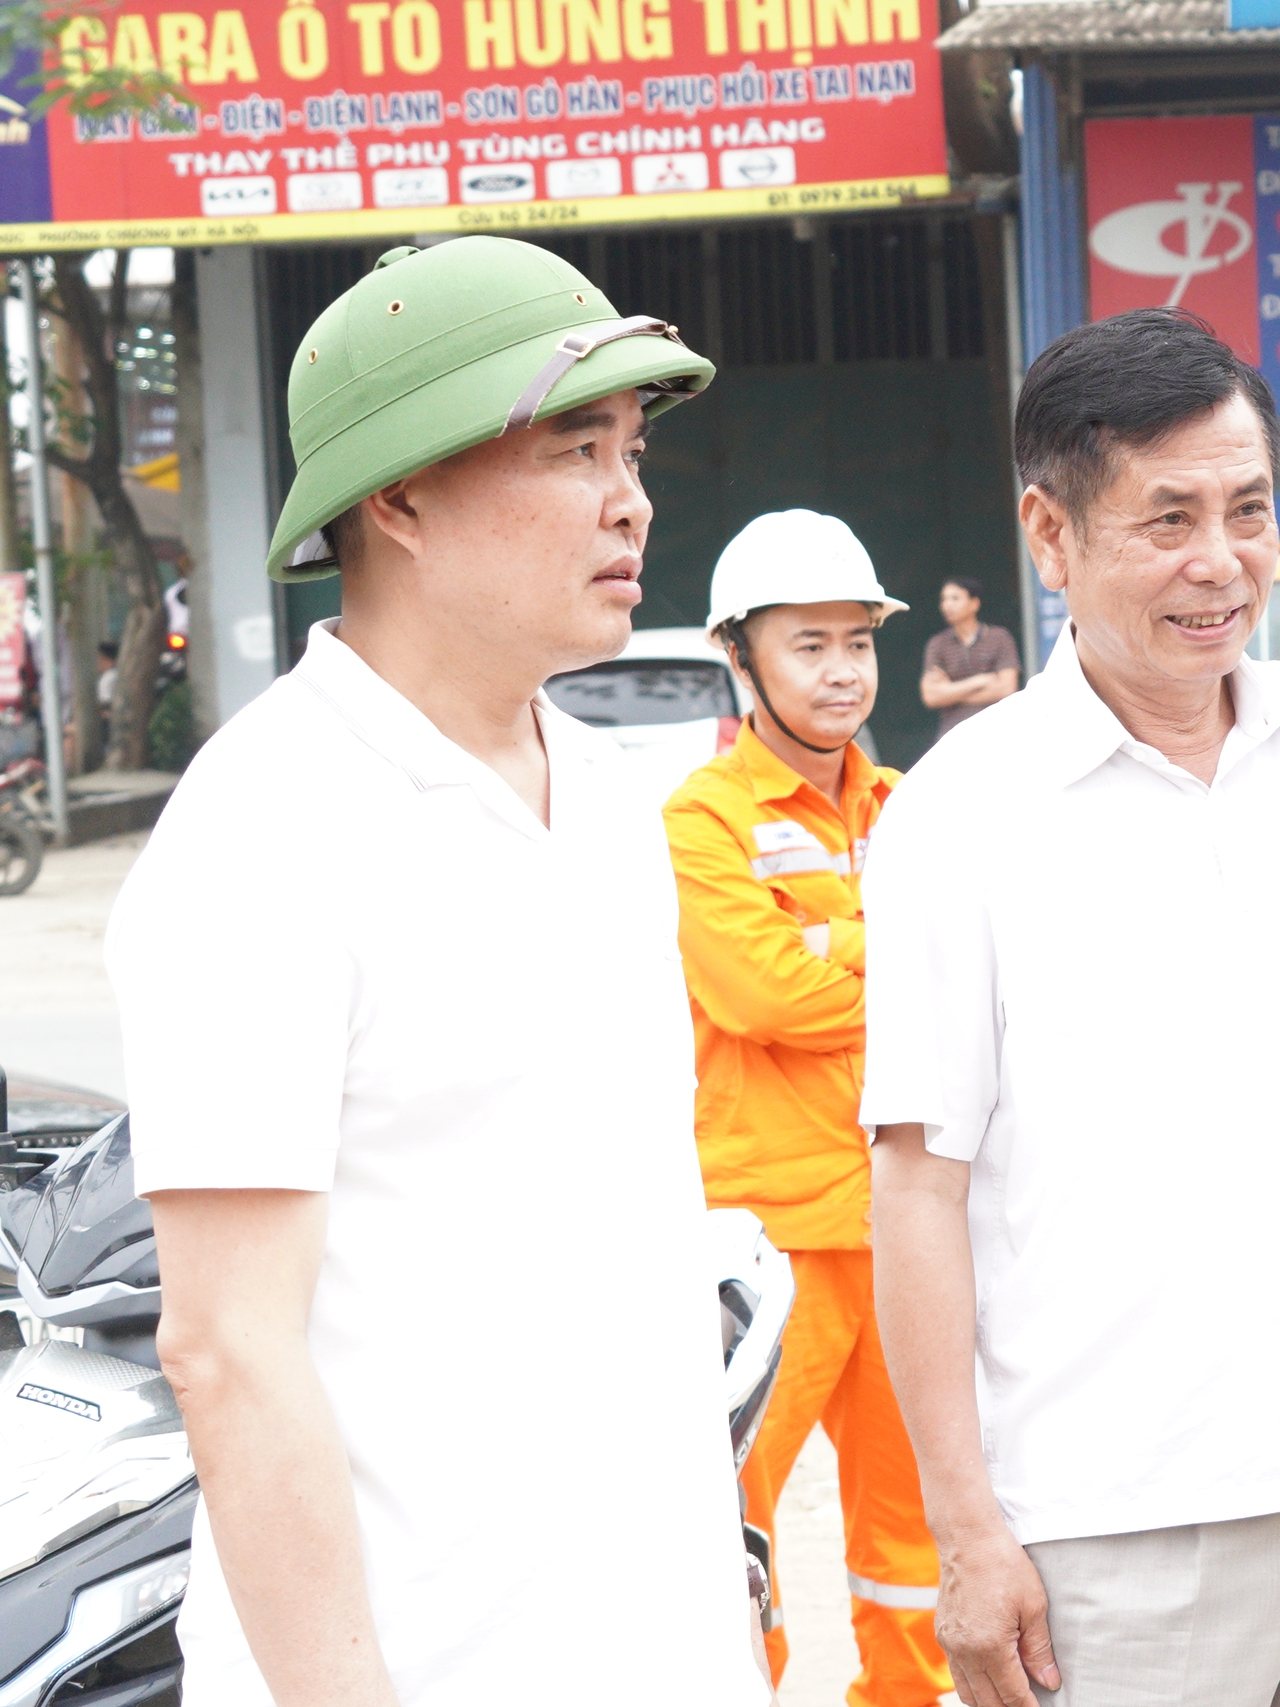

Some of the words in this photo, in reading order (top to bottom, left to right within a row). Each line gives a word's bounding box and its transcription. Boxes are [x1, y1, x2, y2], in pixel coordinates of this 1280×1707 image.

[60, 10, 259, 88] GARA
[221, 94, 284, 140] ĐIỆN
[307, 89, 367, 135] ĐIỆN
[372, 90, 443, 134] LẠNH
[464, 84, 520, 125] SƠN
[565, 76, 622, 118] HÀN
[644, 74, 716, 117] PHỤC
[771, 68, 807, 106] XE
[810, 65, 851, 103] TAI
[855, 59, 914, 105] NẠN
[169, 150, 271, 176] THAY
[458, 133, 567, 162] TÙNG
[575, 125, 701, 156] CHÍNH
[19, 1384, 99, 1421] HONDA
